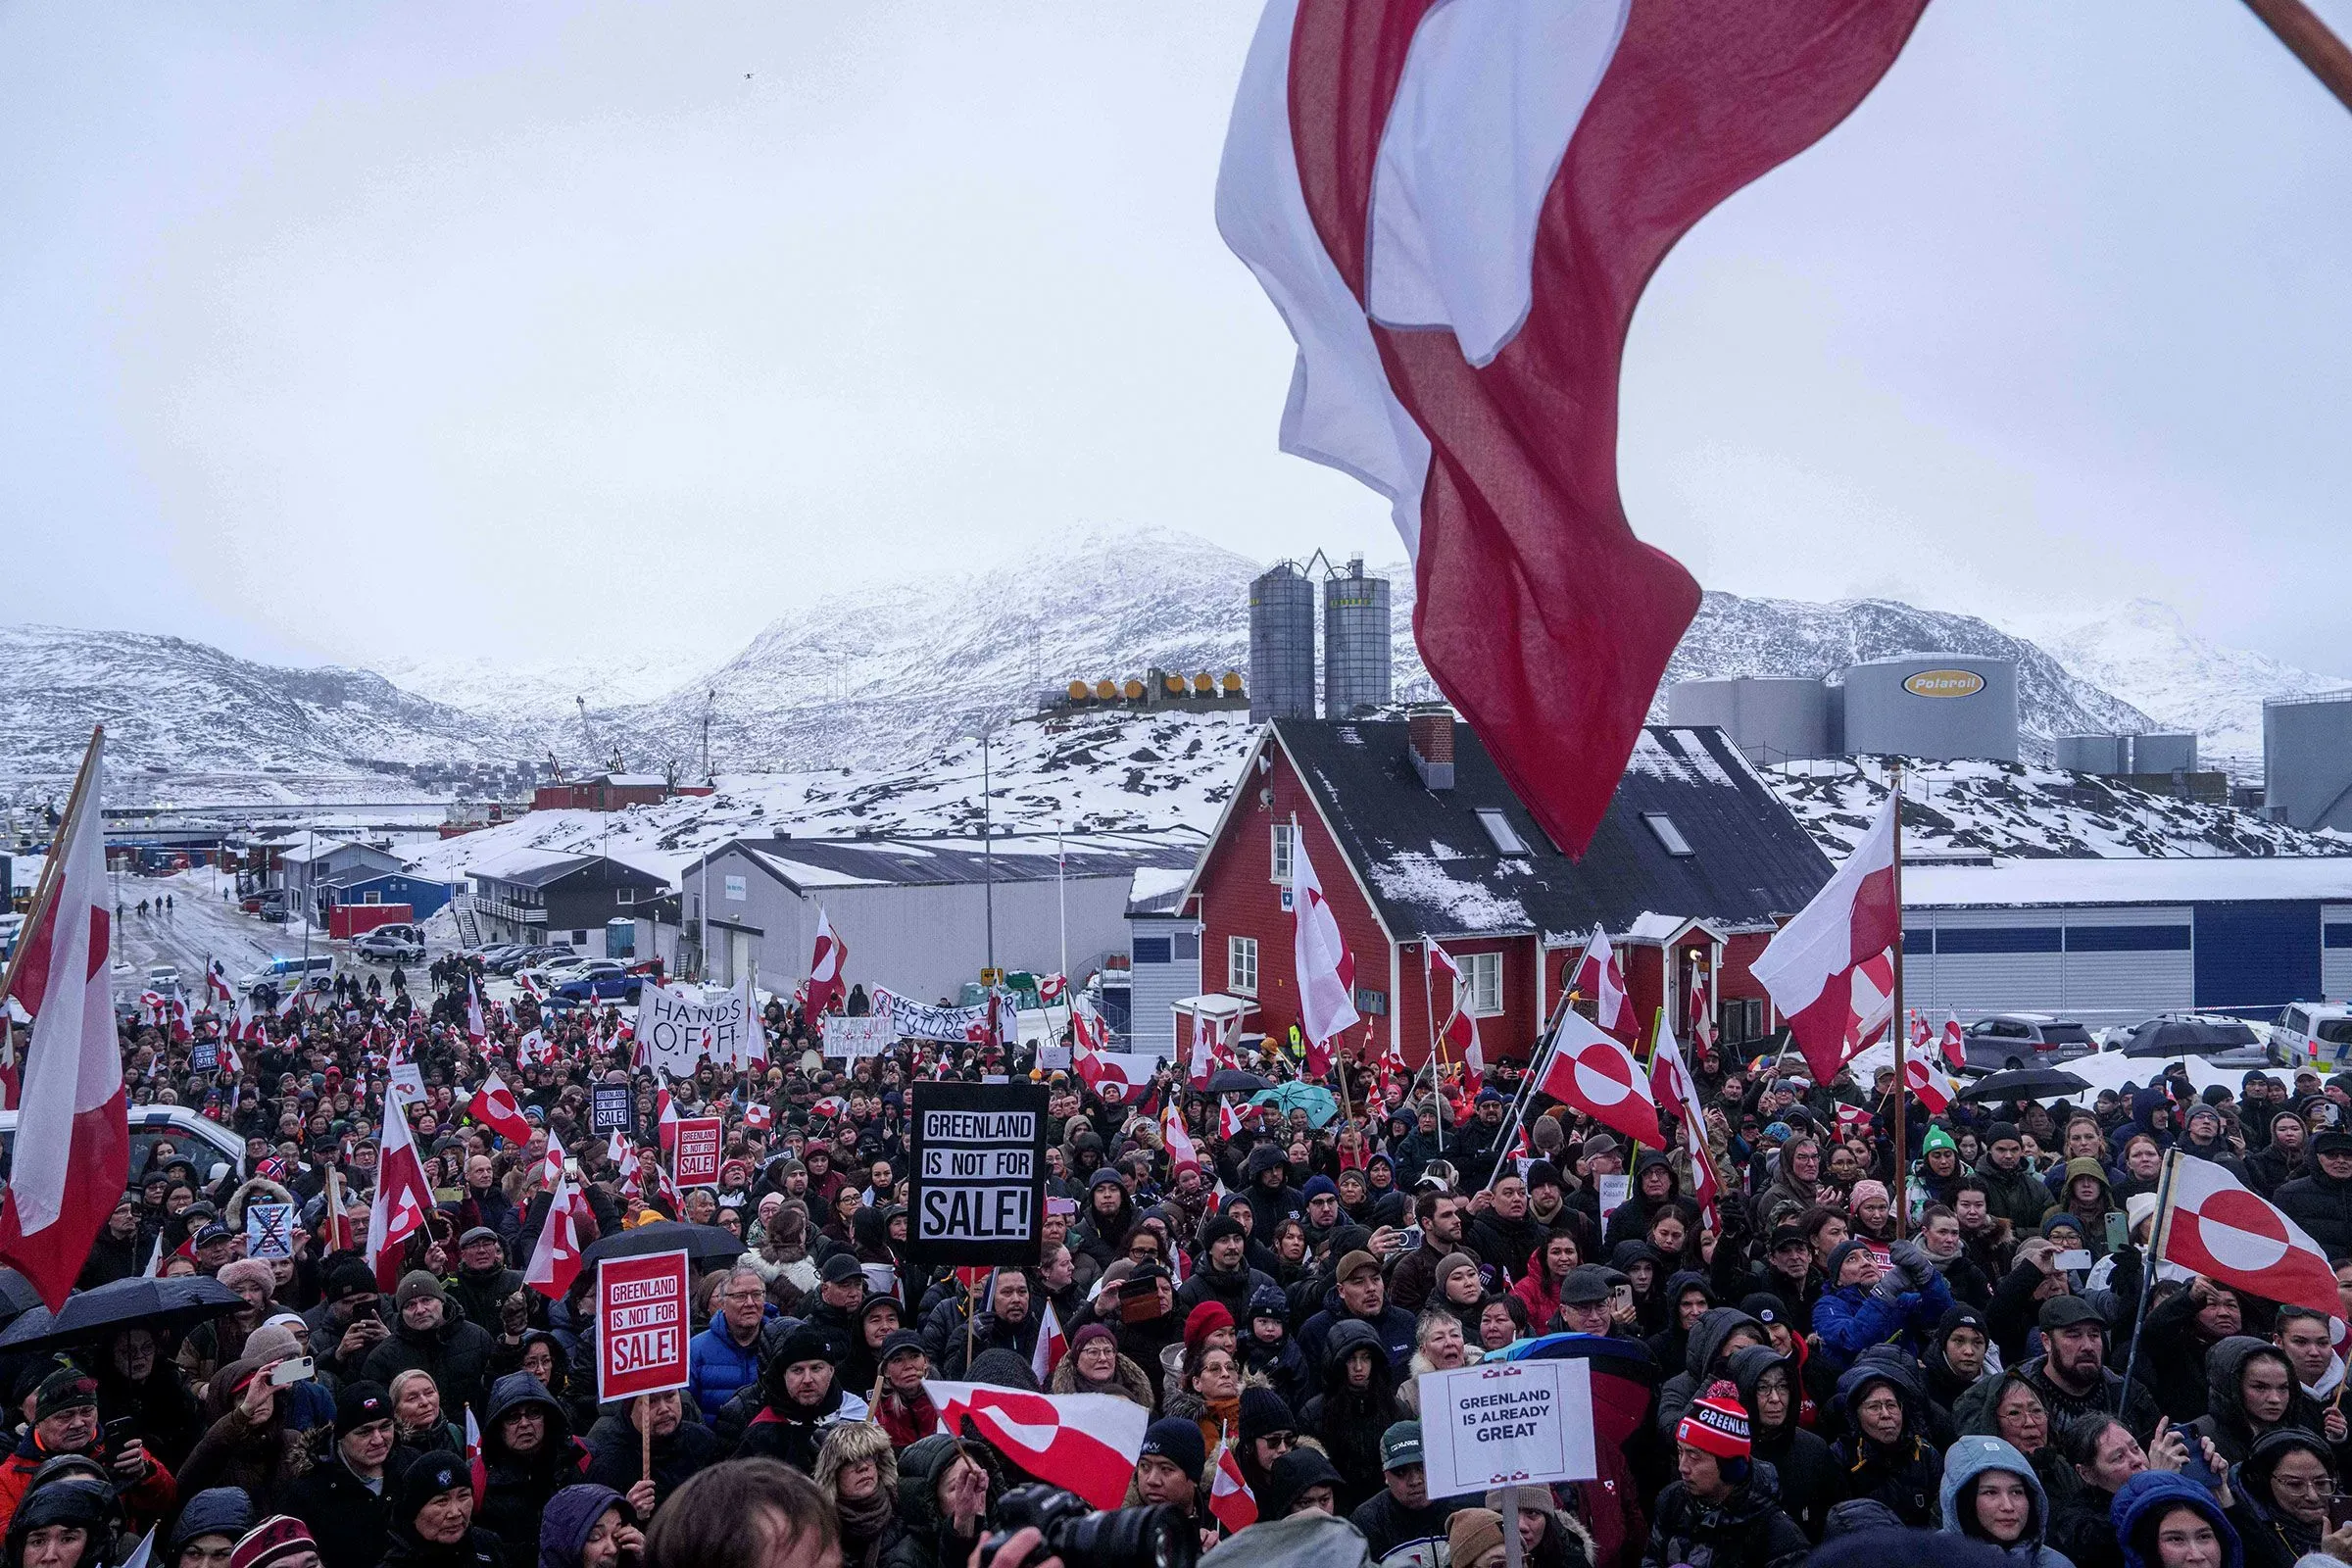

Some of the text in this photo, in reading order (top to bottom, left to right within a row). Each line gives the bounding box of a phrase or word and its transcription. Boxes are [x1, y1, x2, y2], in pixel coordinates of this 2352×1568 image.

[1915, 677, 1977, 689] Polaroil
[654, 998, 741, 1023] HANDS
[598, 1110, 625, 1125] SALE!
[927, 1114, 1032, 1138] GREENLAND
[683, 1130, 715, 1141] GREENLAND
[681, 1155, 714, 1175] SALE!
[925, 1152, 1029, 1175] IS NOT FOR
[923, 1190, 1028, 1237] SALE!
[203, 1224, 224, 1235] BOSS
[612, 1278, 675, 1302] GREENLAND
[612, 1303, 676, 1328] IS NOT FOR
[614, 1329, 677, 1372] SALE!
[1459, 1390, 1551, 1410] GREENLAND
[1462, 1404, 1550, 1426] IS ALREADY
[1476, 1422, 1538, 1443] GREAT
